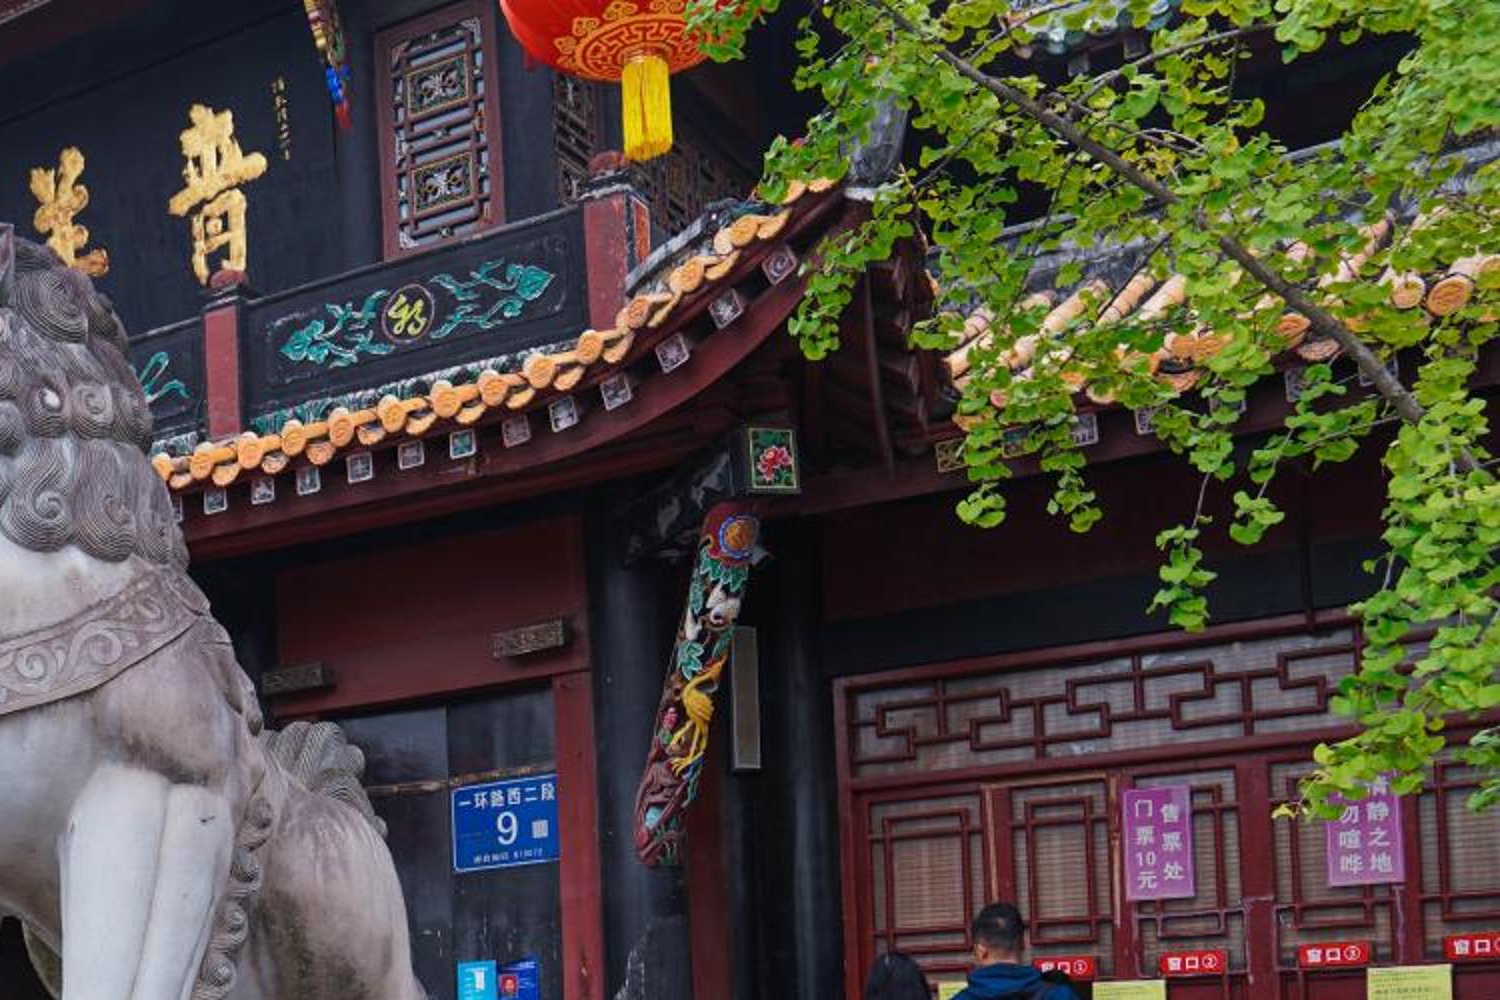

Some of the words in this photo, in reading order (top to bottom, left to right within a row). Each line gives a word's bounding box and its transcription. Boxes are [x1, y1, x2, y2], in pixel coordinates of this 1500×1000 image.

[458, 783, 556, 810] 一环路西二段
[497, 811, 518, 845] 9
[1338, 792, 1363, 874] 勿喧哗
[1134, 799, 1157, 889] 门票10元
[1160, 803, 1184, 881] 售票处
